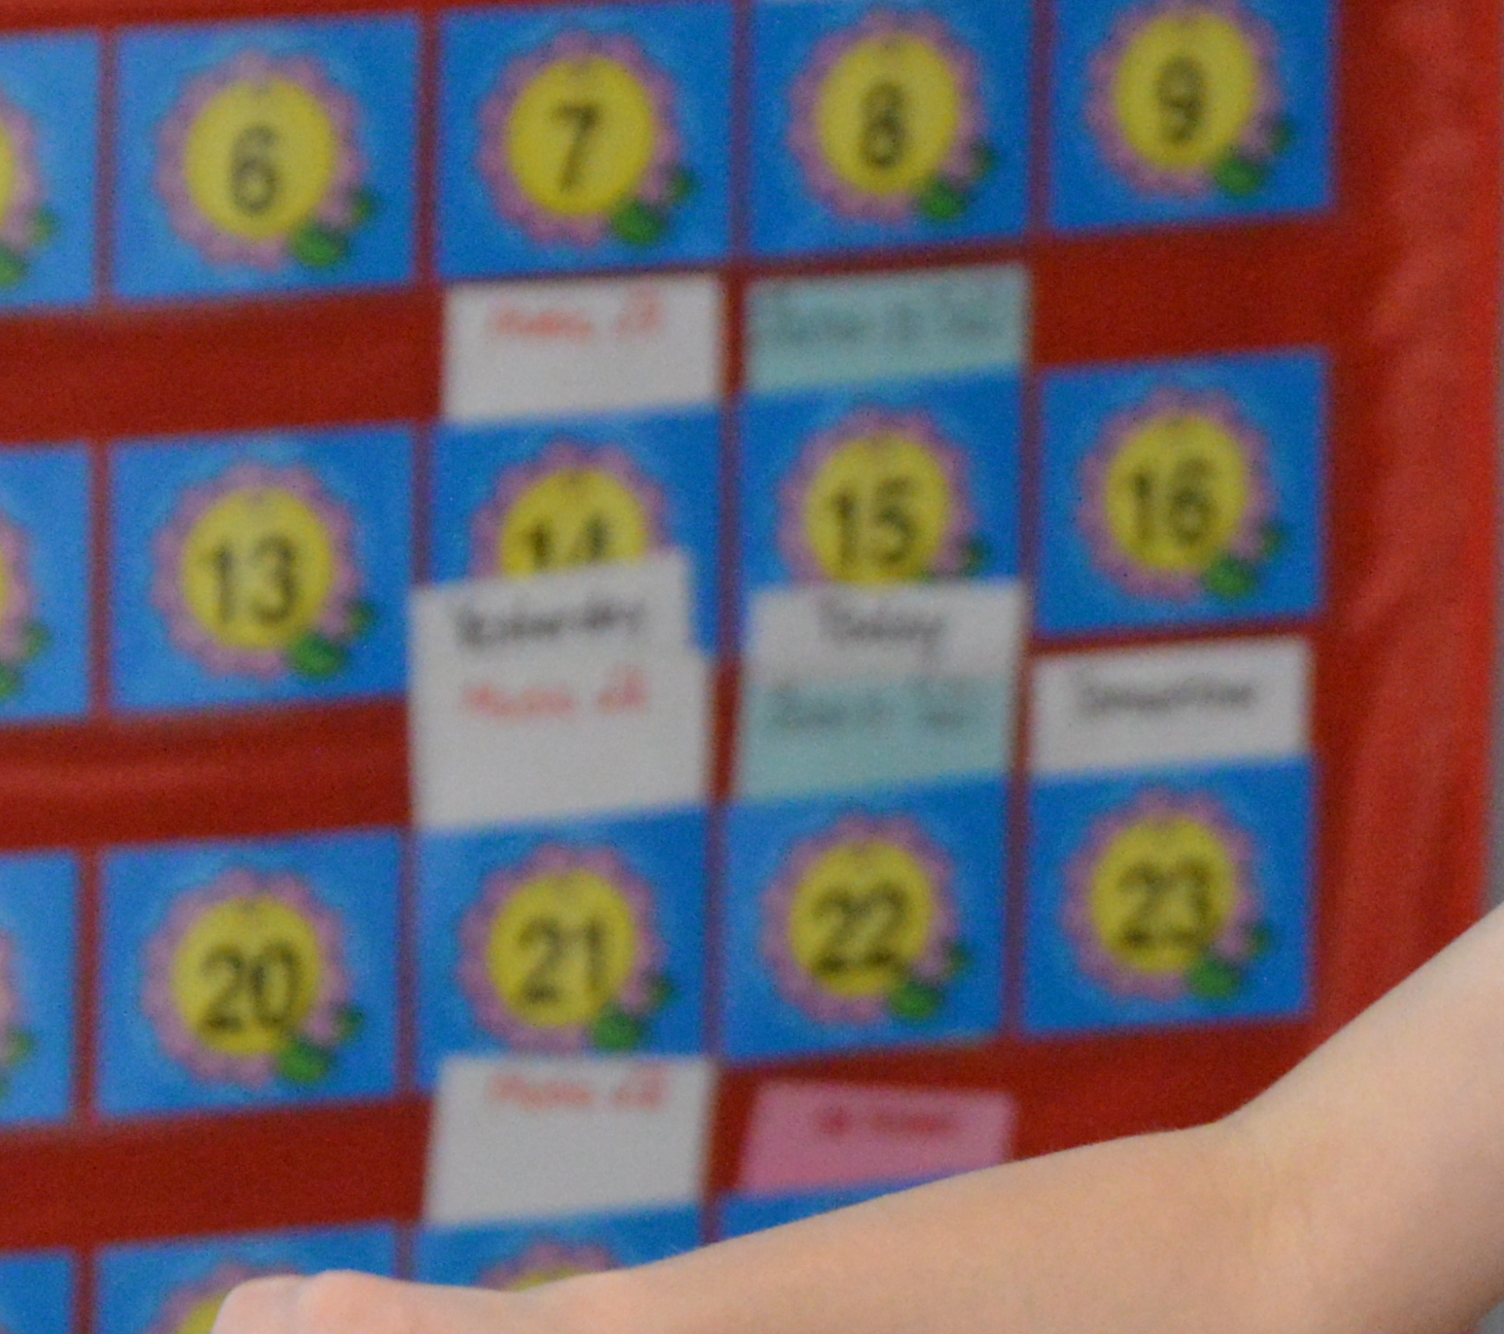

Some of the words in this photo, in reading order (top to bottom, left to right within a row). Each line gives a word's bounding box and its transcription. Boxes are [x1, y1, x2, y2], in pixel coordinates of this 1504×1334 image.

[858, 78, 907, 172] 8
[1156, 53, 1207, 147] 9
[230, 123, 278, 215] 6
[556, 102, 599, 194] 7
[830, 476, 922, 568] 15
[1126, 458, 1214, 544] 16
[203, 542, 294, 628] 13
[813, 884, 908, 975] 22
[1119, 859, 1212, 947] 23
[200, 943, 296, 1034] 20
[517, 917, 608, 1006] 21
